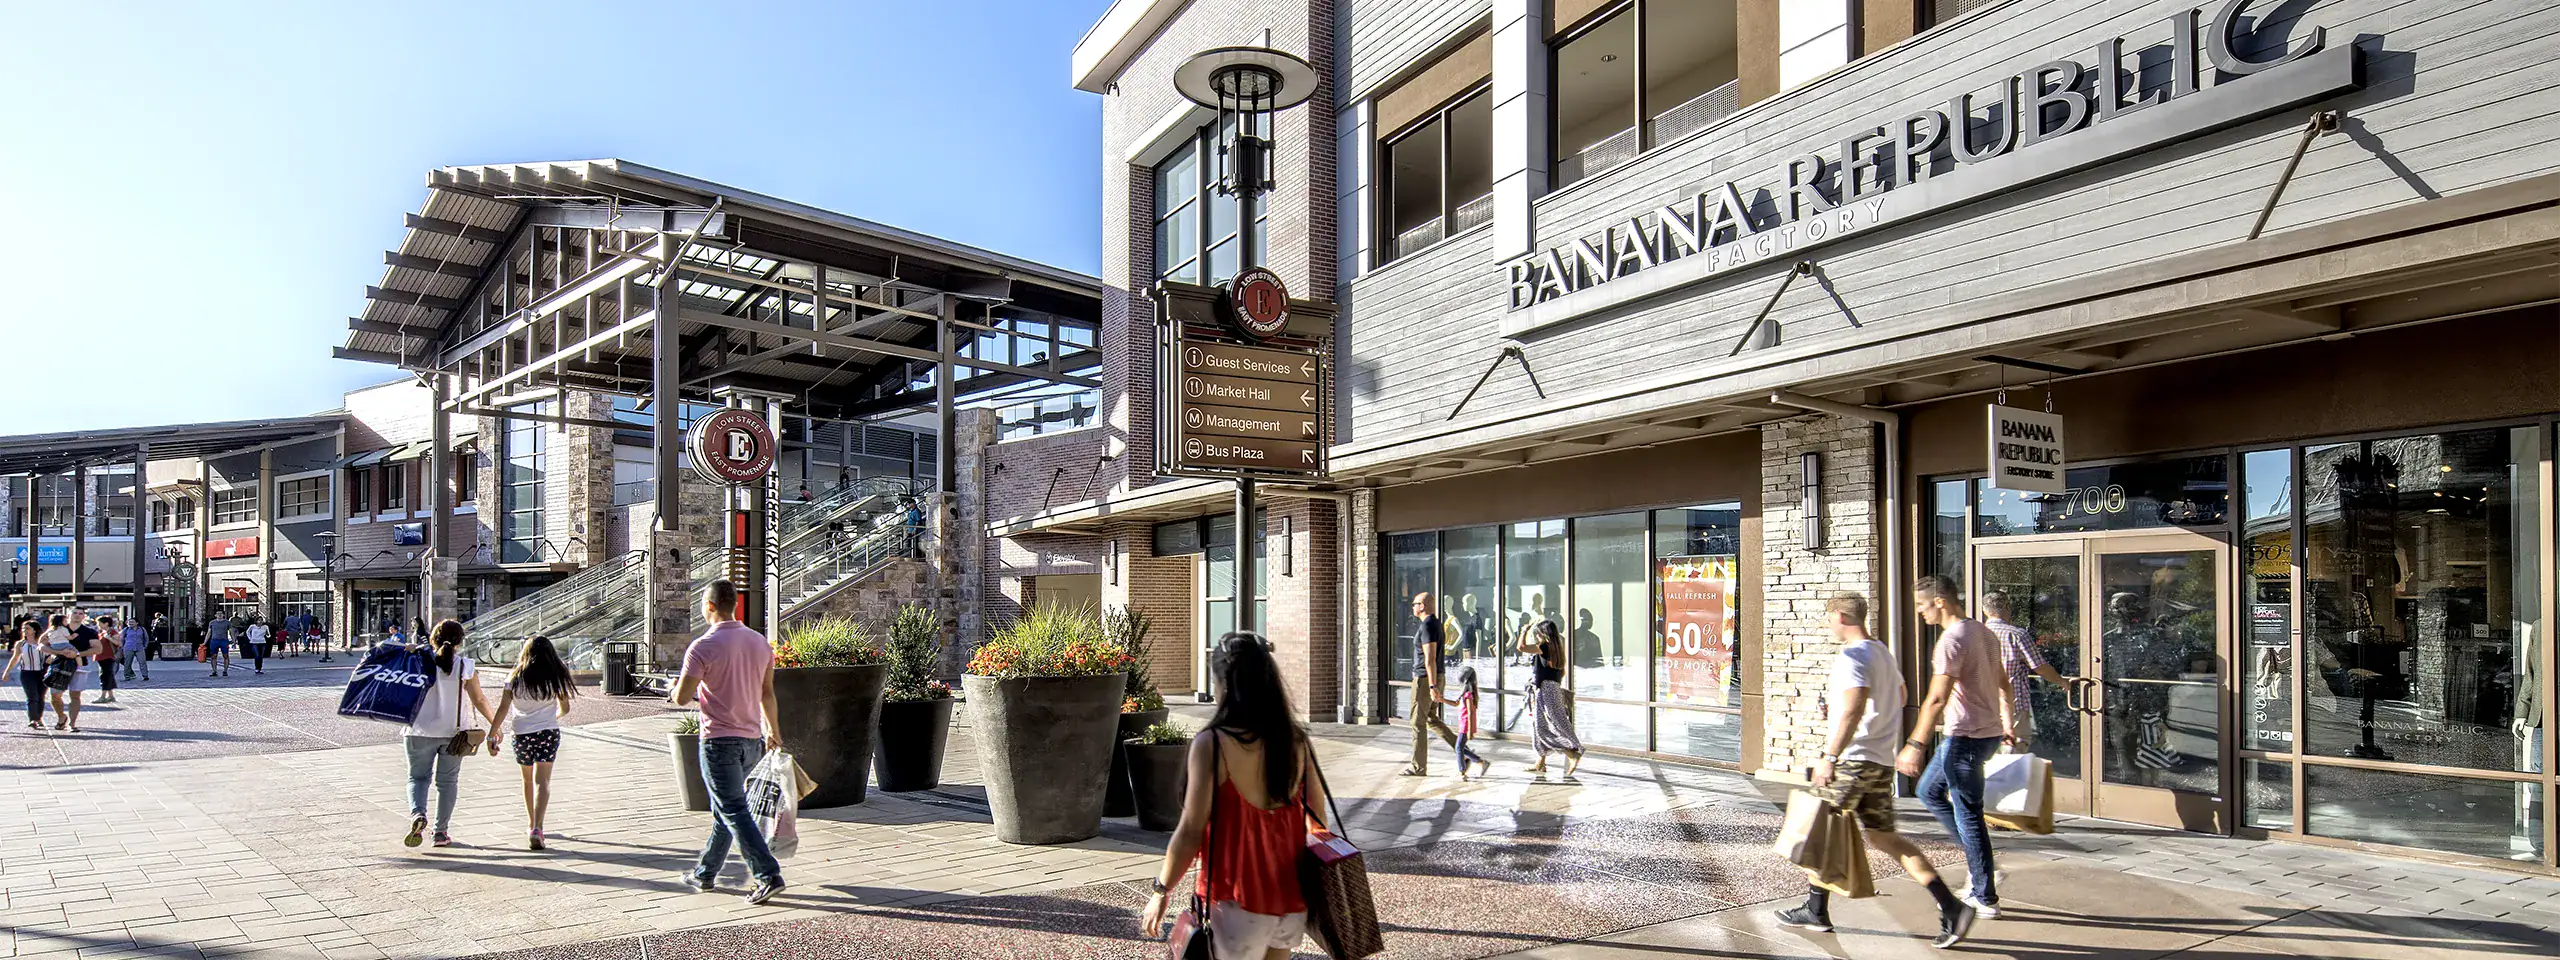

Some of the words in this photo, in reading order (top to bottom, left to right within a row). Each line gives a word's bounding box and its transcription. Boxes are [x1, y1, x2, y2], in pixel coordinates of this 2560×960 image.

[1506, 181, 1759, 314] BANANA
[1779, 0, 2326, 223] REPUBLIC
[1707, 198, 1885, 273] FACTORY
[1241, 272, 1257, 287] LOW
[1258, 272, 1283, 289] STREET
[1256, 289, 1272, 315] E
[1237, 306, 1253, 324] EAST
[1251, 311, 1288, 332] PROMENADE
[1206, 355, 1240, 370] Guest
[1243, 358, 1291, 374] Services
[1206, 384, 1246, 399] Market
[1249, 388, 1270, 401] Hall
[716, 416, 734, 430] LOW
[736, 415, 764, 434] STREET
[1206, 414, 1281, 432] Management
[2001, 419, 2056, 443] BANANA
[728, 432, 750, 461] E
[1206, 444, 1229, 458] Bus
[1232, 446, 1264, 460] Plaza
[1998, 442, 2061, 466] REPUBLIC
[711, 450, 727, 469] EAST
[727, 455, 770, 477] PROMENADE
[2065, 484, 2125, 516] 700
[181, 567, 192, 577] W
[1666, 592, 1681, 600] FALL
[1685, 592, 1717, 600] REFRESH
[1666, 621, 1717, 656] 50%
[1702, 648, 1717, 657] OFF
[1666, 660, 1679, 669] OR
[1683, 661, 1714, 672] MORE
[2357, 719, 2413, 731] BANANA
[2416, 722, 2484, 736] REPUBLIC
[2385, 732, 2453, 743] FACTORY
